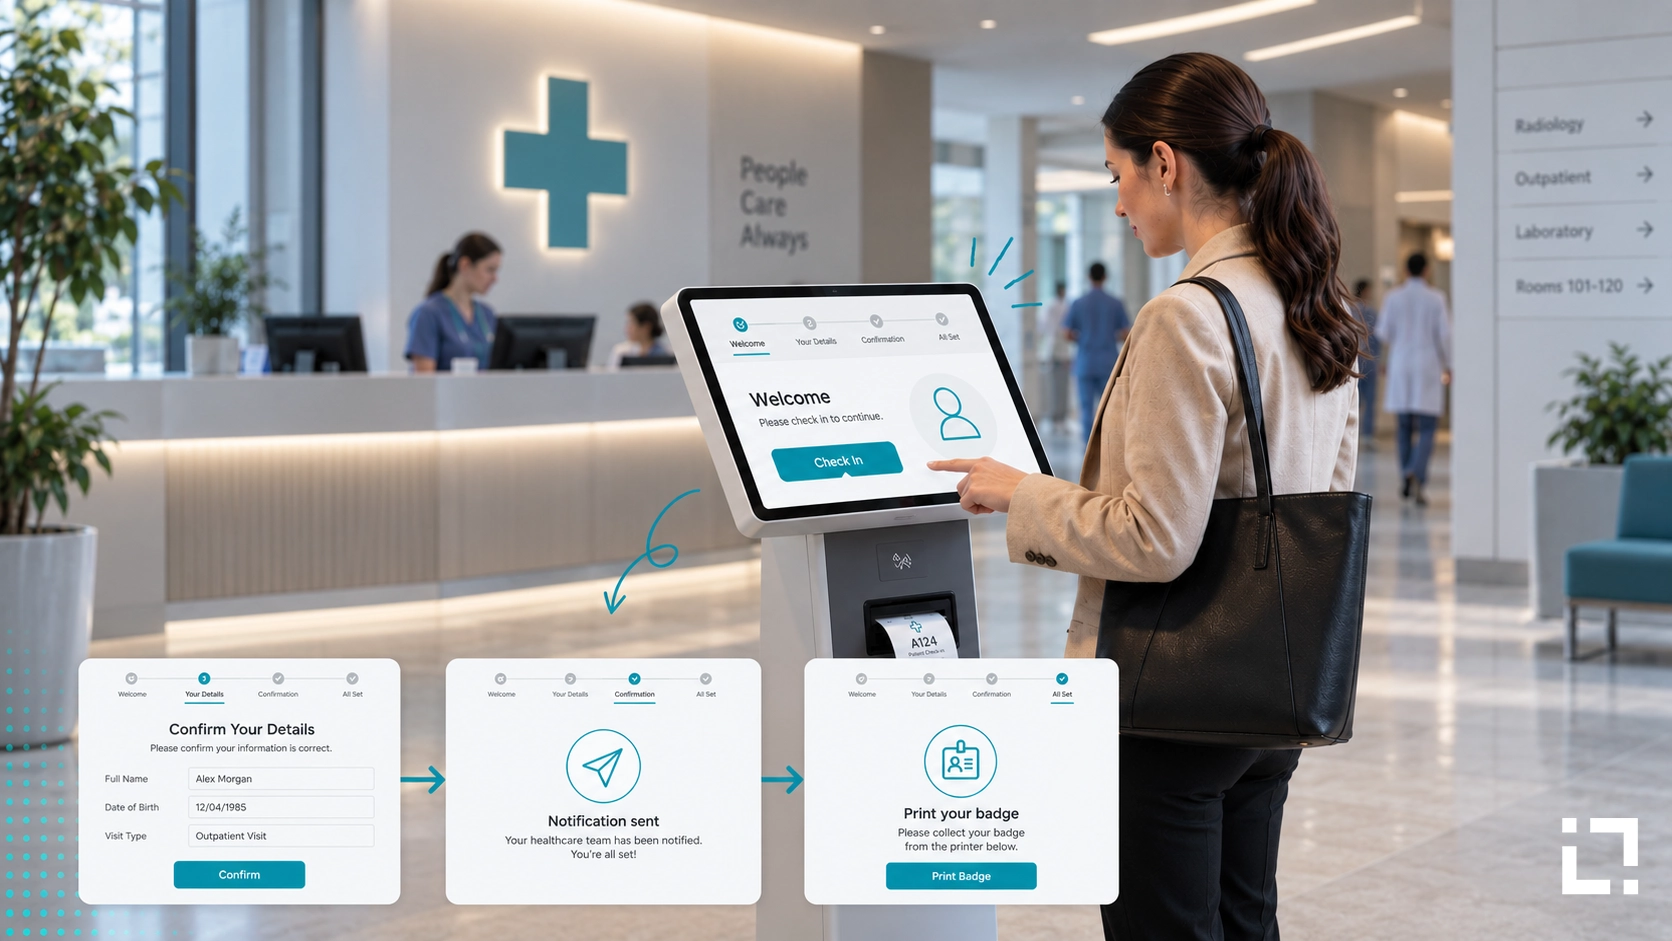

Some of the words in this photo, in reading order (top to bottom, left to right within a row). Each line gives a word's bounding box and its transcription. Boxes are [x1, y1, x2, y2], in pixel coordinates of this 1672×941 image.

[1515, 116, 1584, 134] Radiology
[740, 155, 808, 190] People
[1515, 171, 1591, 188] Outpatient
[740, 189, 787, 217] Care
[740, 223, 809, 256] Always
[1516, 225, 1593, 241] Laboratory
[1516, 279, 1562, 294] Rooms
[1568, 279, 1623, 293] 101-120
[749, 391, 830, 407] Welcome
[759, 418, 789, 427] Please
[791, 415, 818, 425] check
[819, 415, 829, 423] in
[830, 415, 840, 423] to
[842, 412, 883, 422] continue.
[814, 456, 850, 468] Check
[851, 456, 863, 465] In
[912, 636, 937, 648] A124
